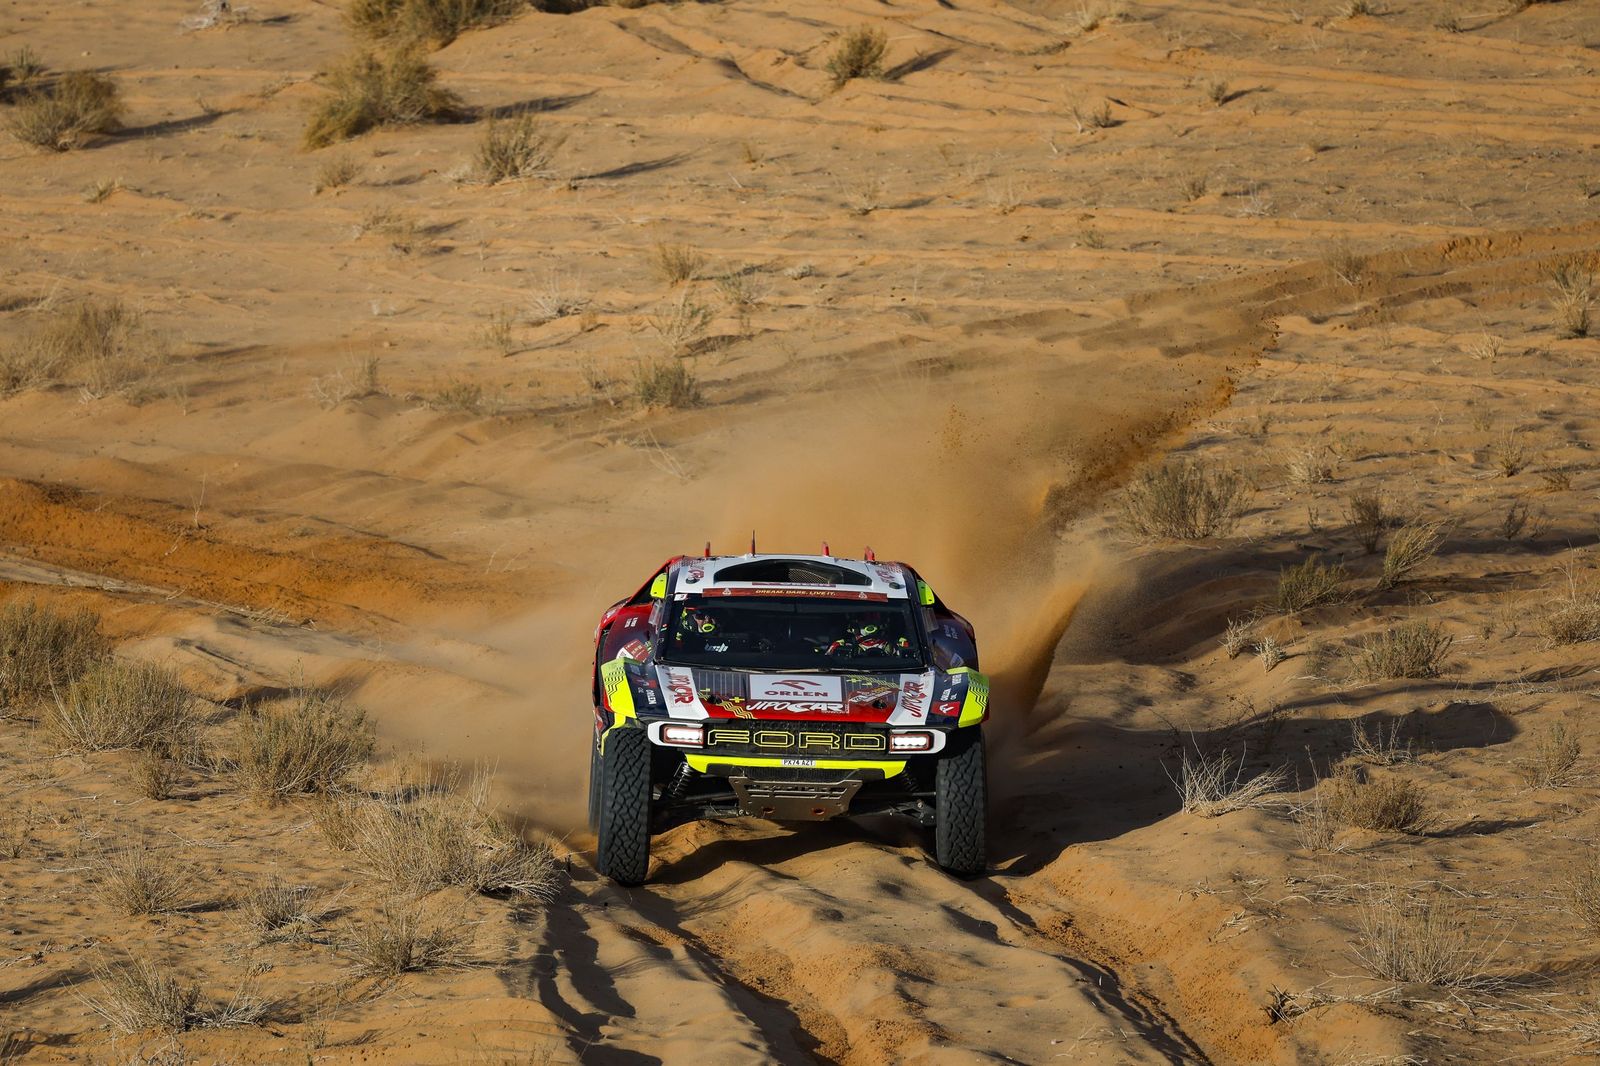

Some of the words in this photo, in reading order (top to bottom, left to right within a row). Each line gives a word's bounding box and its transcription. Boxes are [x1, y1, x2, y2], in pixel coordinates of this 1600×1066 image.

[646, 689, 656, 705] ORLEN
[746, 701, 844, 713] JIPOCAR
[707, 729, 886, 751] FORD
